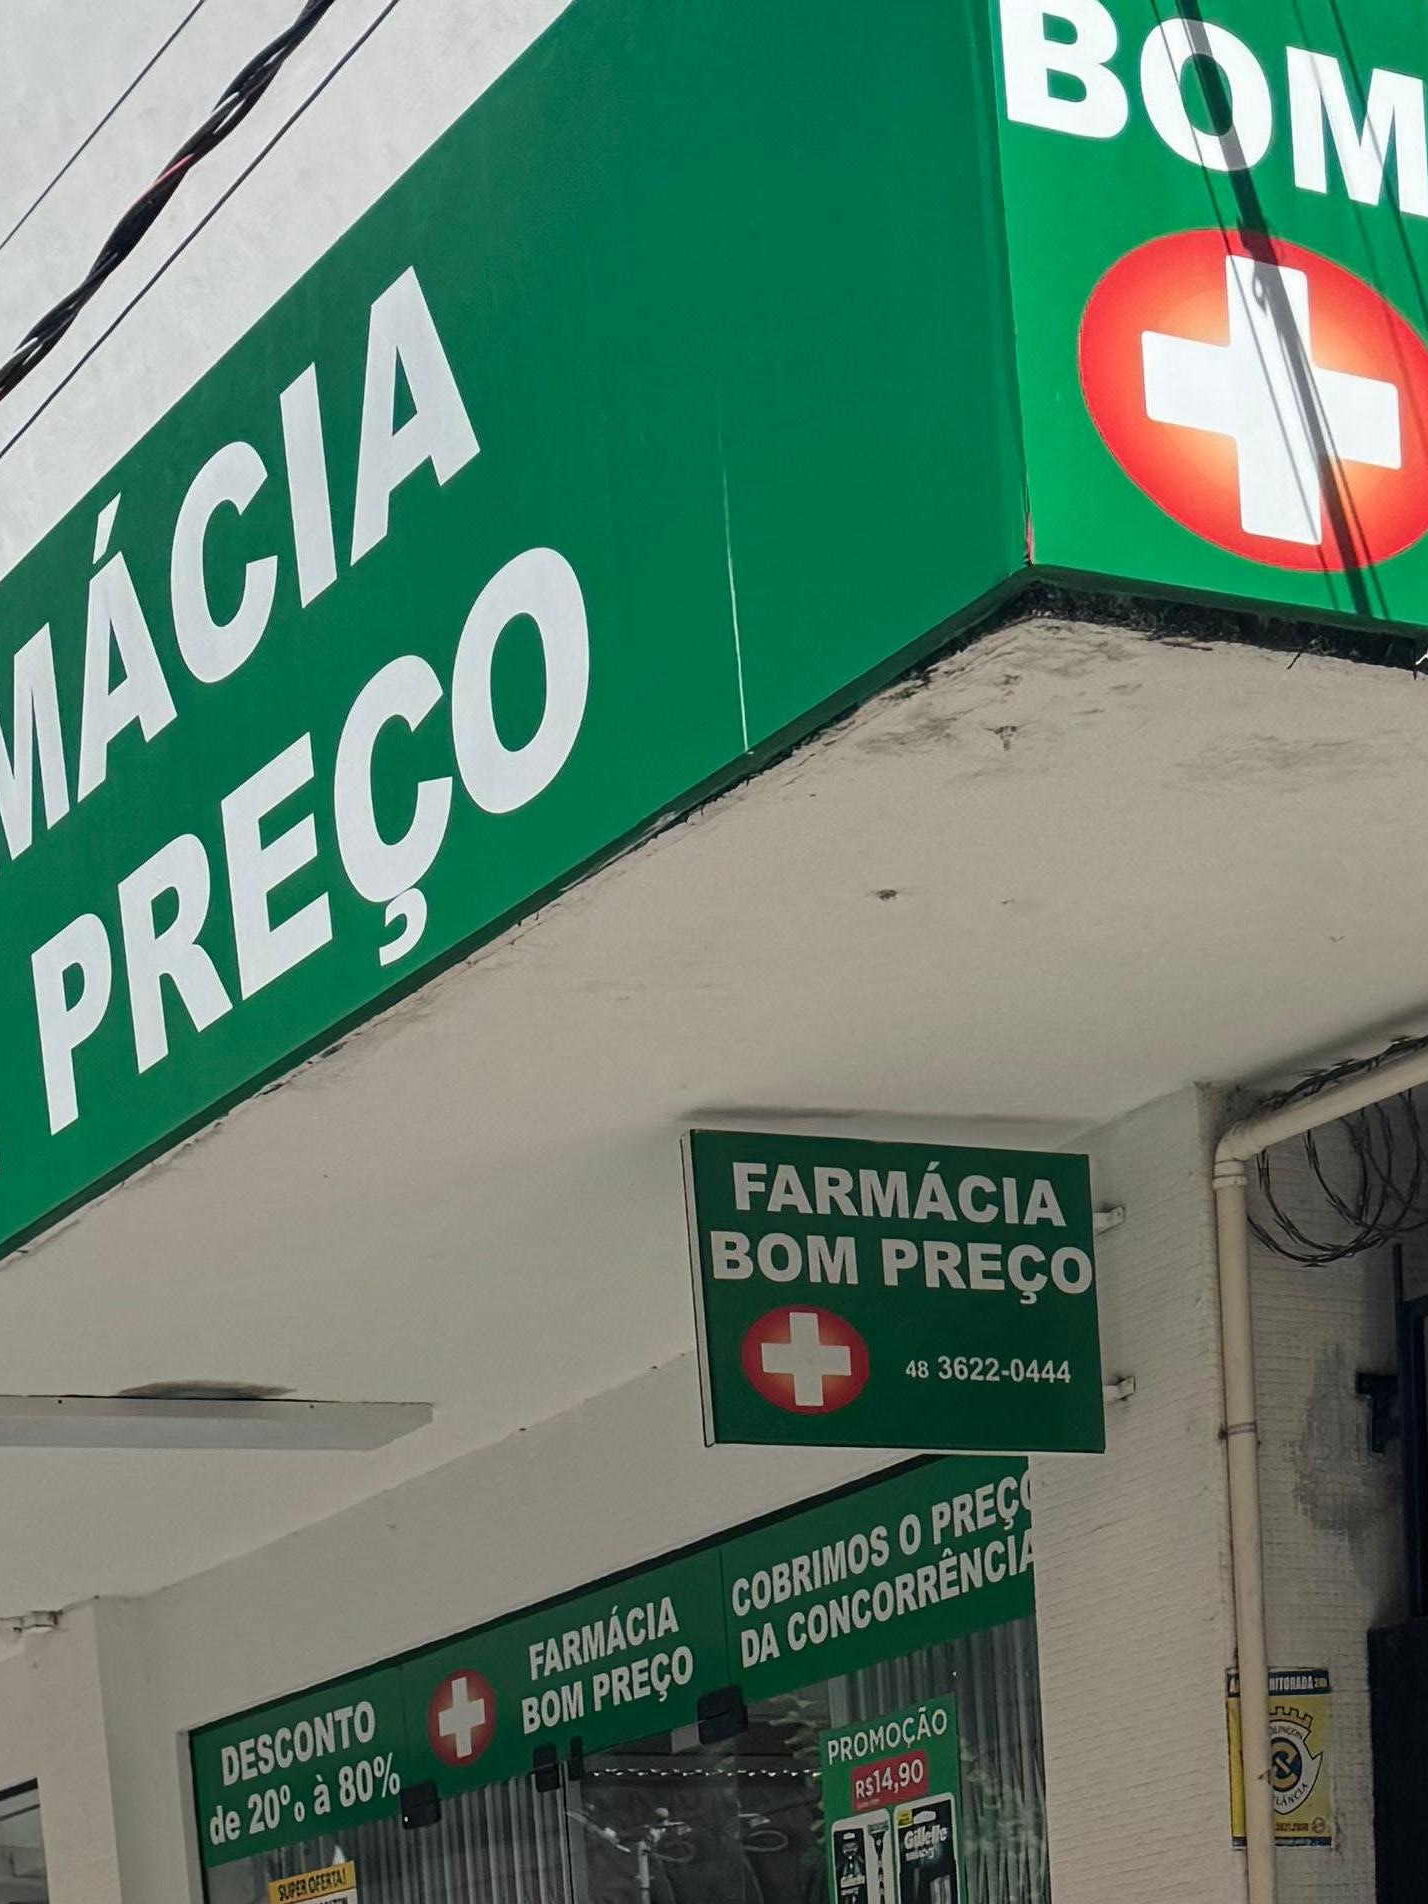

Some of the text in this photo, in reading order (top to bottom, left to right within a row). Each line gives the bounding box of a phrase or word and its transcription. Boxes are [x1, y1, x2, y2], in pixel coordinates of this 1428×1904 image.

[29, 546, 592, 1138] PREÇO
[732, 1161, 1066, 1227] FARMÁCIA
[710, 1231, 1093, 1305] BOM PREÇO
[905, 1356, 1071, 1383] 48 3622-0444
[731, 1526, 889, 1617] COBRIMOS
[899, 1512, 922, 1555] O
[740, 1526, 1034, 1669] DA CONCORRÊNCIA
[528, 1595, 679, 1681] FARMÁCIA
[521, 1646, 694, 1735] BOM PREÇO
[220, 1700, 376, 1787] DESCONTO
[827, 1707, 948, 1765] PROMOÇÃO
[855, 1758, 924, 1799] R$14,90
[209, 1751, 401, 1846] de 20% à 80%
[278, 1879, 308, 1901] SUPER
